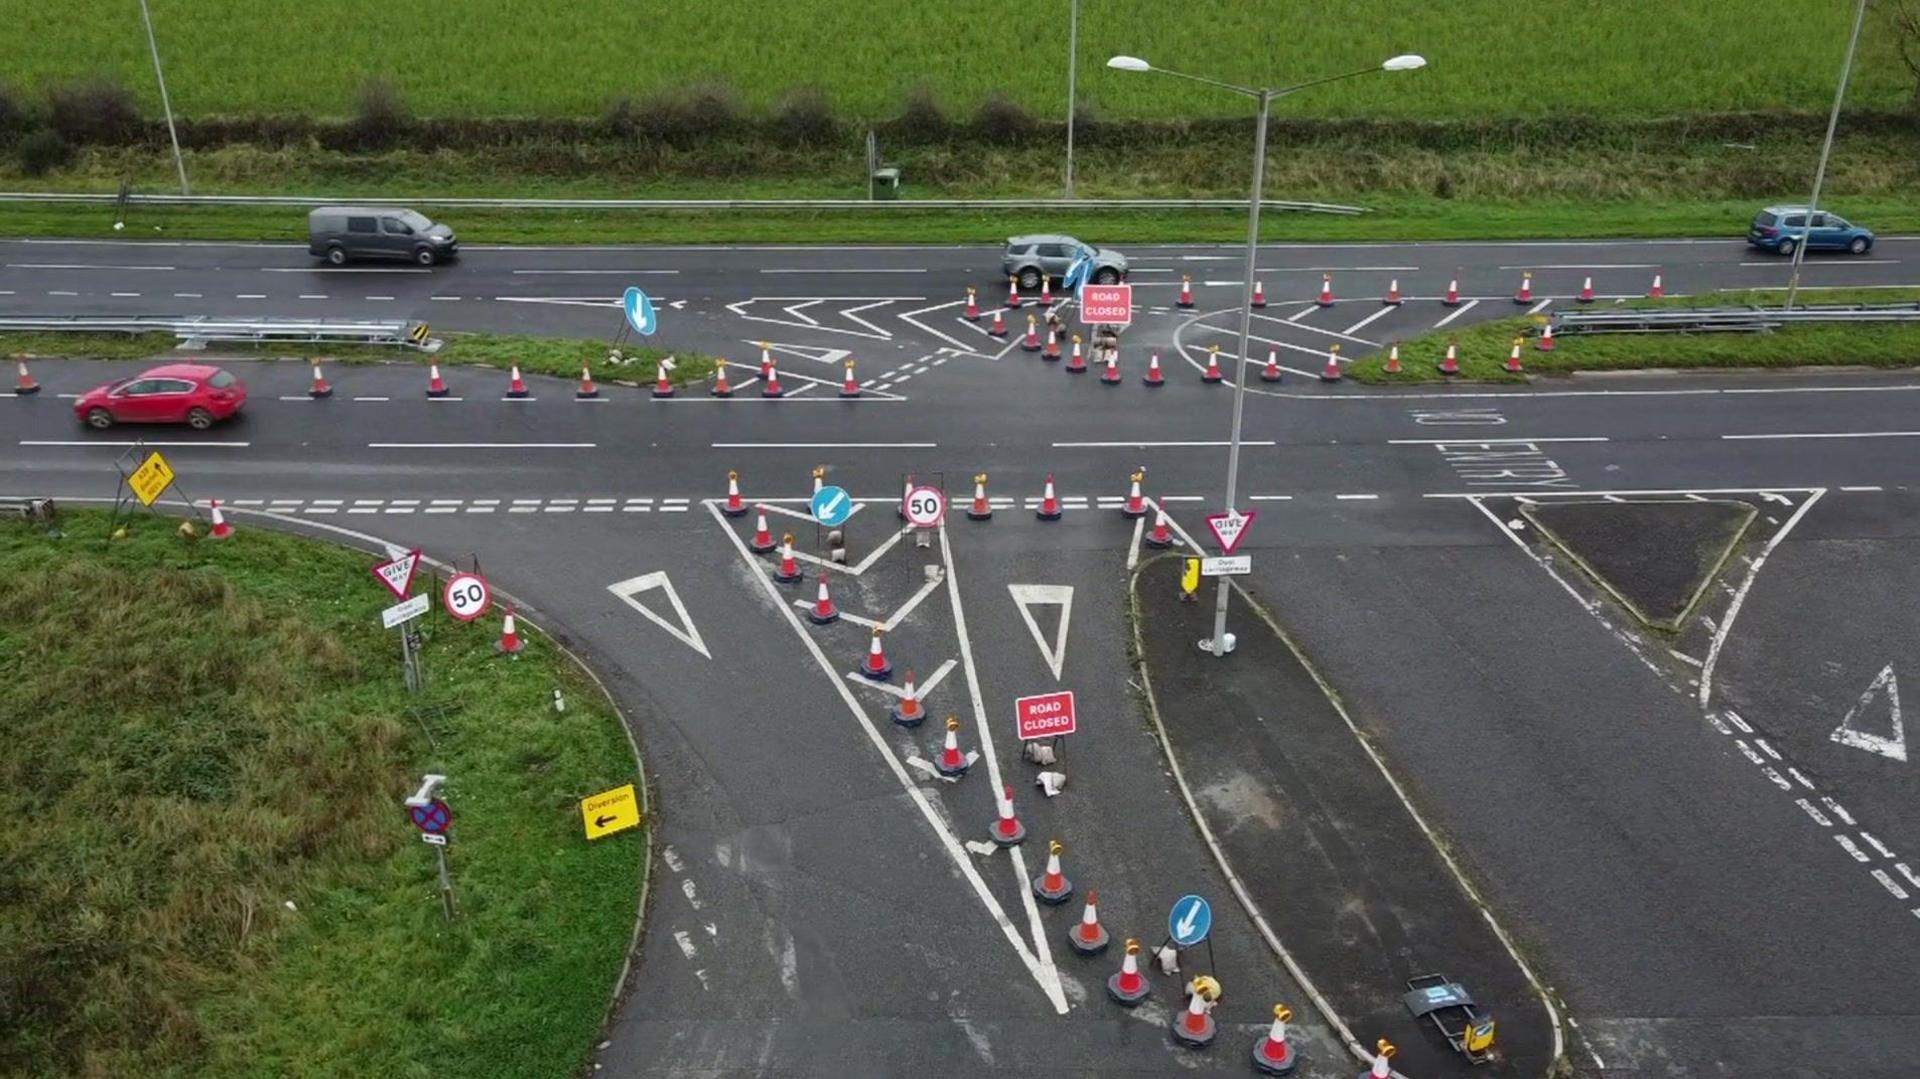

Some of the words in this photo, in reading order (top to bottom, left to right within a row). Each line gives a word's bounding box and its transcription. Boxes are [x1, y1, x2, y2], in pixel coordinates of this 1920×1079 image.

[1092, 292, 1120, 302] ROAD
[1086, 306, 1126, 316] CLOSED
[1434, 442, 1580, 488] ENTRY
[911, 498, 937, 515] 50
[1215, 518, 1242, 529] GIVE
[383, 561, 410, 577] GIVE
[391, 572, 408, 583] WAY
[453, 584, 482, 608] 50
[1029, 702, 1061, 715] ROAD
[1024, 716, 1069, 731] CLOSED
[588, 793, 629, 812] Diversion
